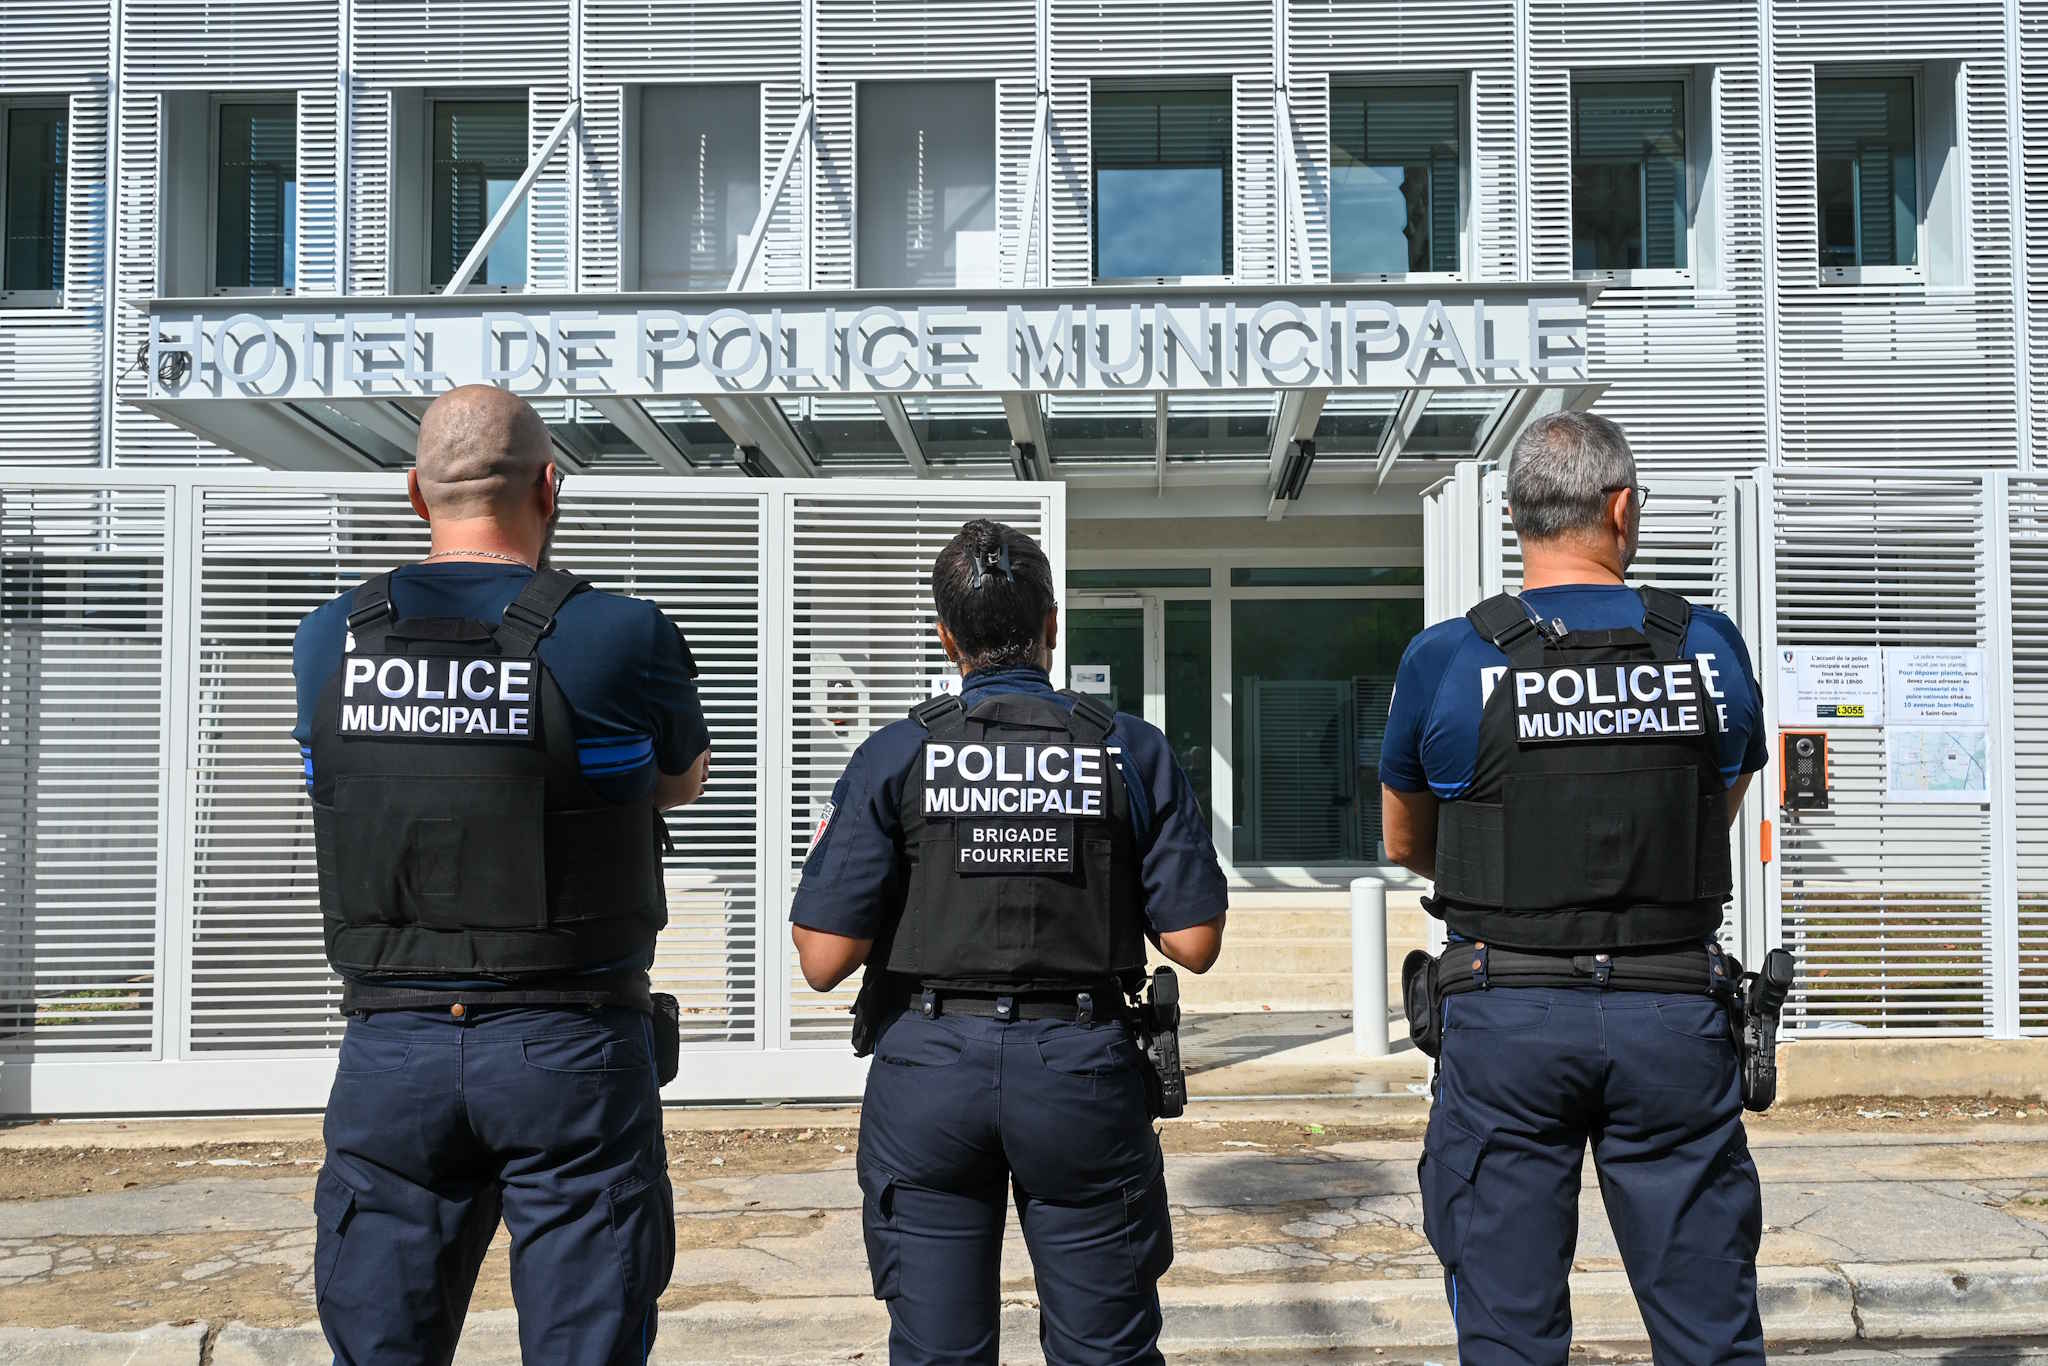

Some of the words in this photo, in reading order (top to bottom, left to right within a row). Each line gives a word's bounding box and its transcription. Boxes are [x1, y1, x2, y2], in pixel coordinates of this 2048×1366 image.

[150, 312, 447, 384] HOTEL
[482, 311, 600, 383] DE
[637, 305, 968, 381] POLICE
[1006, 297, 1581, 375] MUNICIPALE
[344, 657, 532, 701] POLICE
[1515, 663, 1697, 709] POLICE
[1914, 669, 1939, 677] déposer
[341, 704, 530, 736] MUNICIPALE
[1518, 706, 1701, 739] MUNICIPALE
[1842, 706, 1864, 715] 3055
[925, 744, 1103, 785] POLICE
[925, 788, 1102, 816] MUNICIPALE
[972, 828, 1057, 843] BRIGADE
[960, 849, 1069, 864] FOURRIERE
